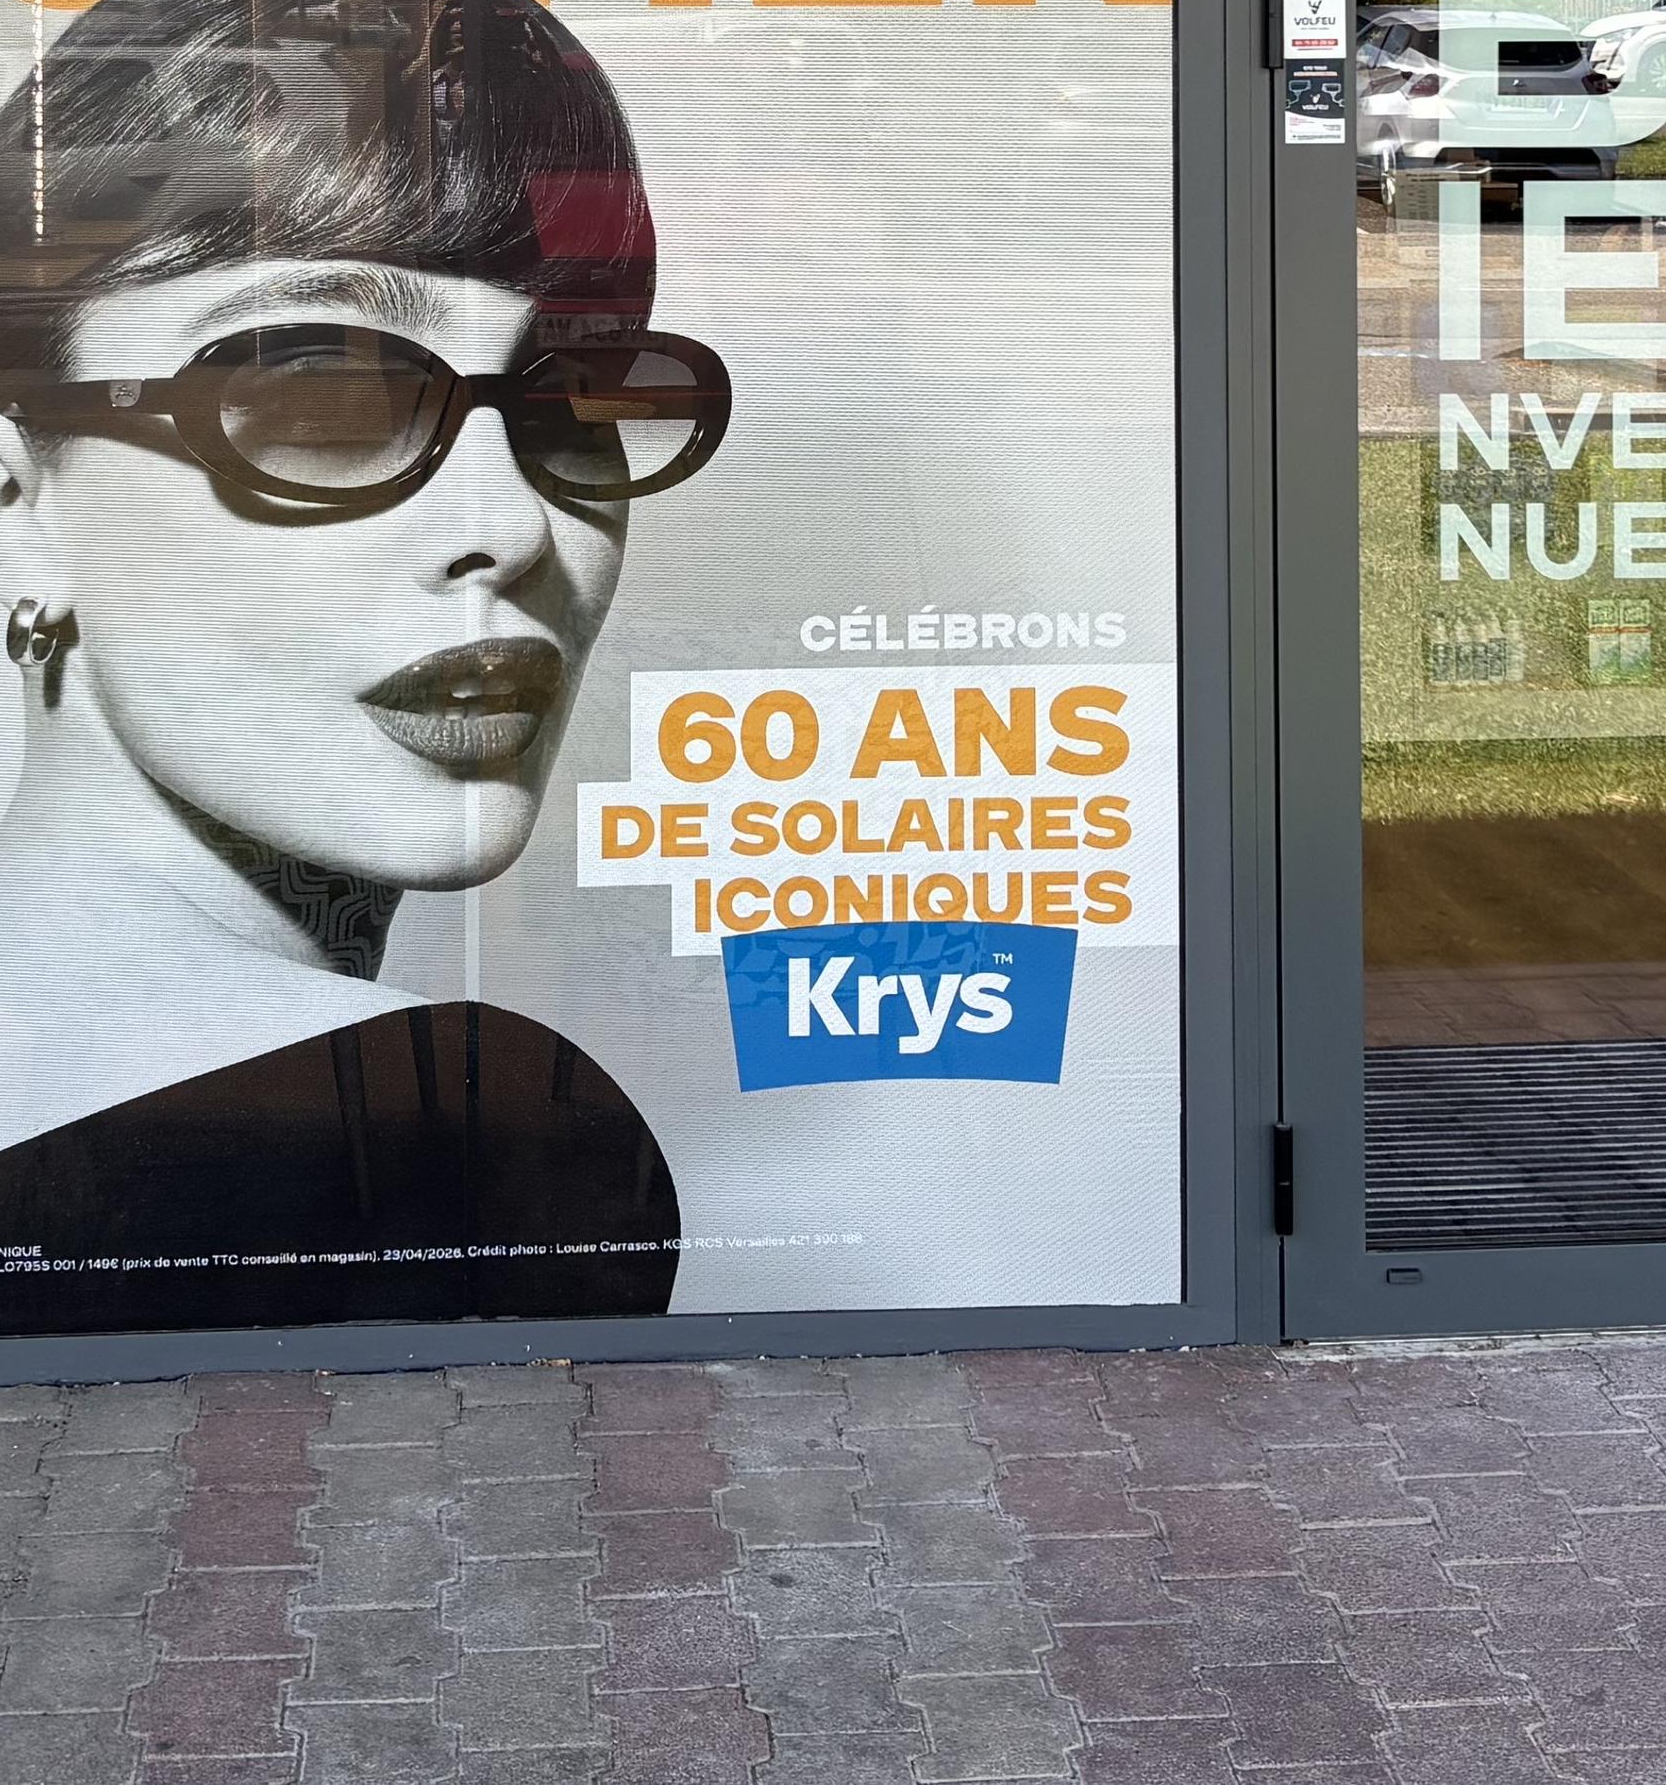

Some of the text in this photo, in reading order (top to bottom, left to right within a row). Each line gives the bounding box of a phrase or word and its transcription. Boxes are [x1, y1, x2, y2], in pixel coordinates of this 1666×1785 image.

[1294, 17, 1336, 26] VOLFEU
[799, 605, 1128, 651] CÉLÉBRONS
[658, 685, 1130, 783] 60 ANS
[601, 795, 1132, 860] DE SOLAIRES
[694, 870, 1133, 934] ICONIQUES
[788, 957, 1013, 1055] Krys
[121, 1257, 151, 1271] (prix
[154, 1256, 170, 1268] de
[173, 1256, 208, 1267] vente
[212, 1254, 239, 1265] TTC
[242, 1252, 297, 1265] conseillé
[300, 1254, 316, 1264] en
[467, 1244, 506, 1258] Crédit
[509, 1244, 547, 1258] photo
[556, 1242, 597, 1254] Louise
